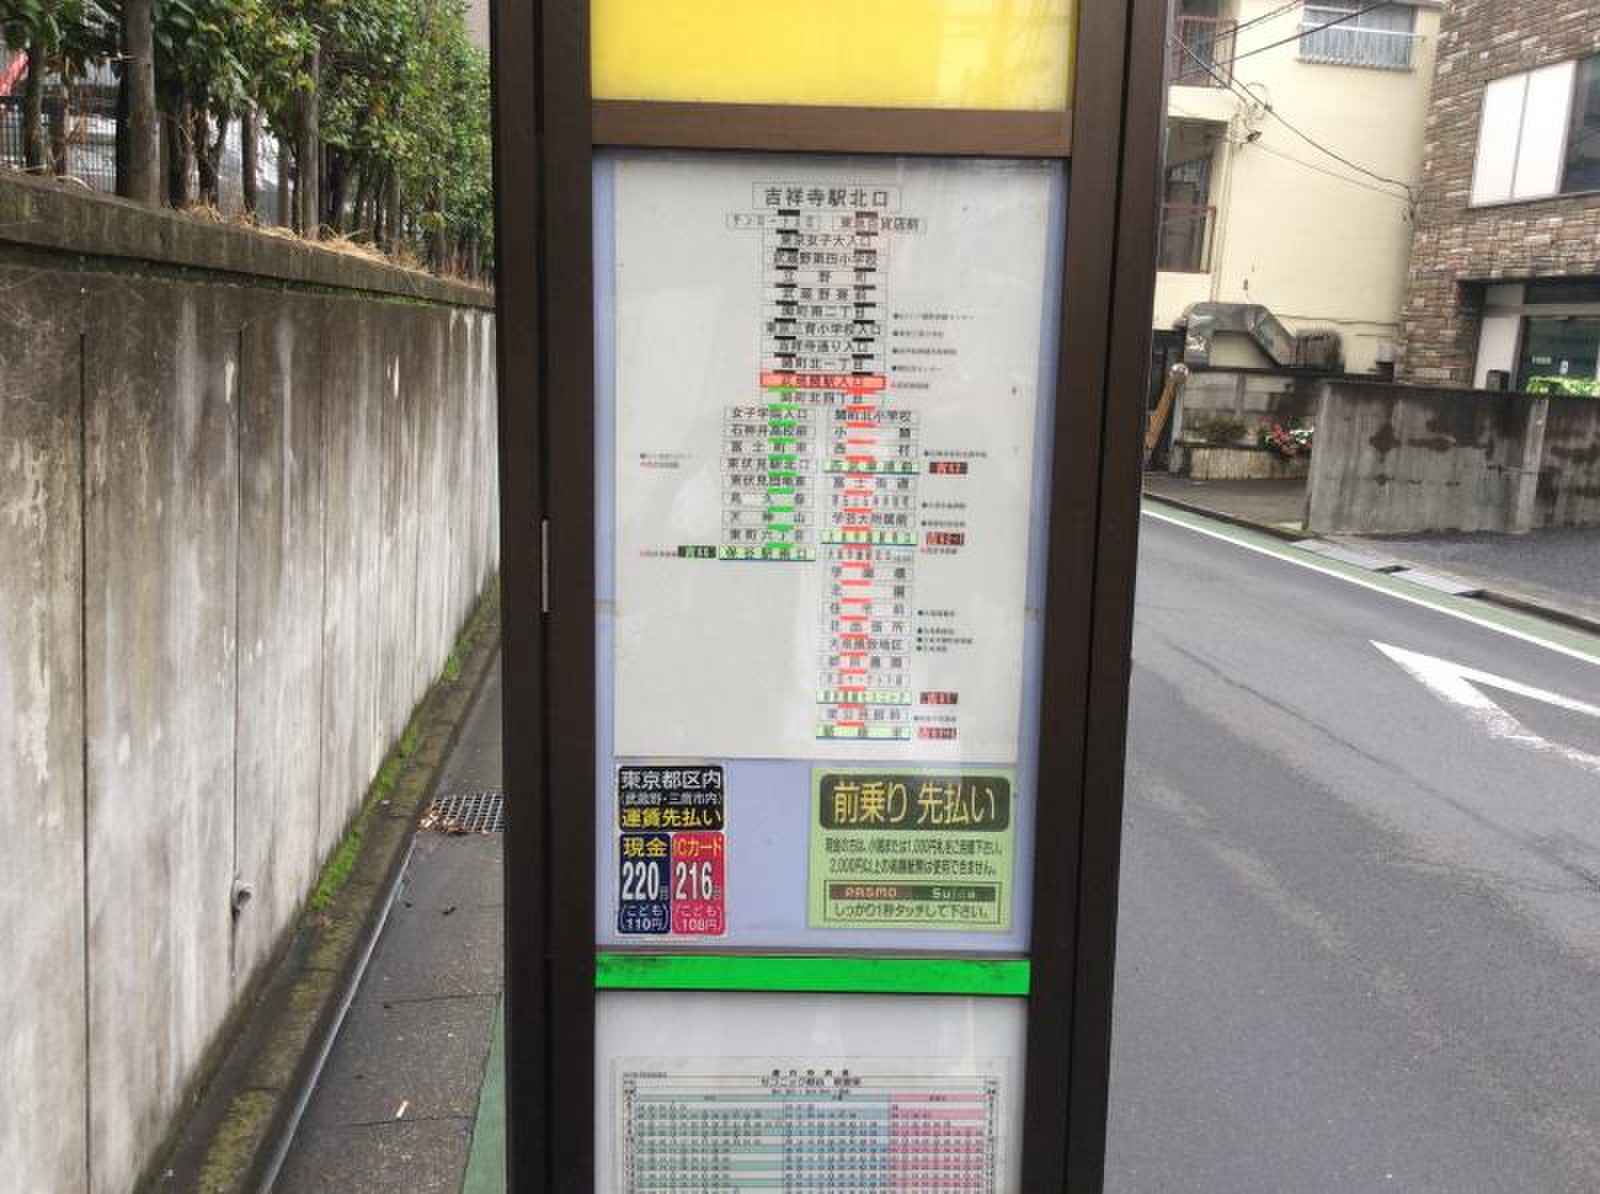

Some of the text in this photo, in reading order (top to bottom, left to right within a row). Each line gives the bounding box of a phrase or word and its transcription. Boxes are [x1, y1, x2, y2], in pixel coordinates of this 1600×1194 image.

[765, 188, 888, 207] 吉祥寺駅北口
[621, 770, 721, 790] 東京都区内
[833, 781, 995, 824] 前乗り 先払い
[622, 807, 721, 827] 運賃先払い
[623, 837, 668, 857] 現金
[673, 837, 722, 857] ICカード
[845, 887, 897, 898] PASMO
